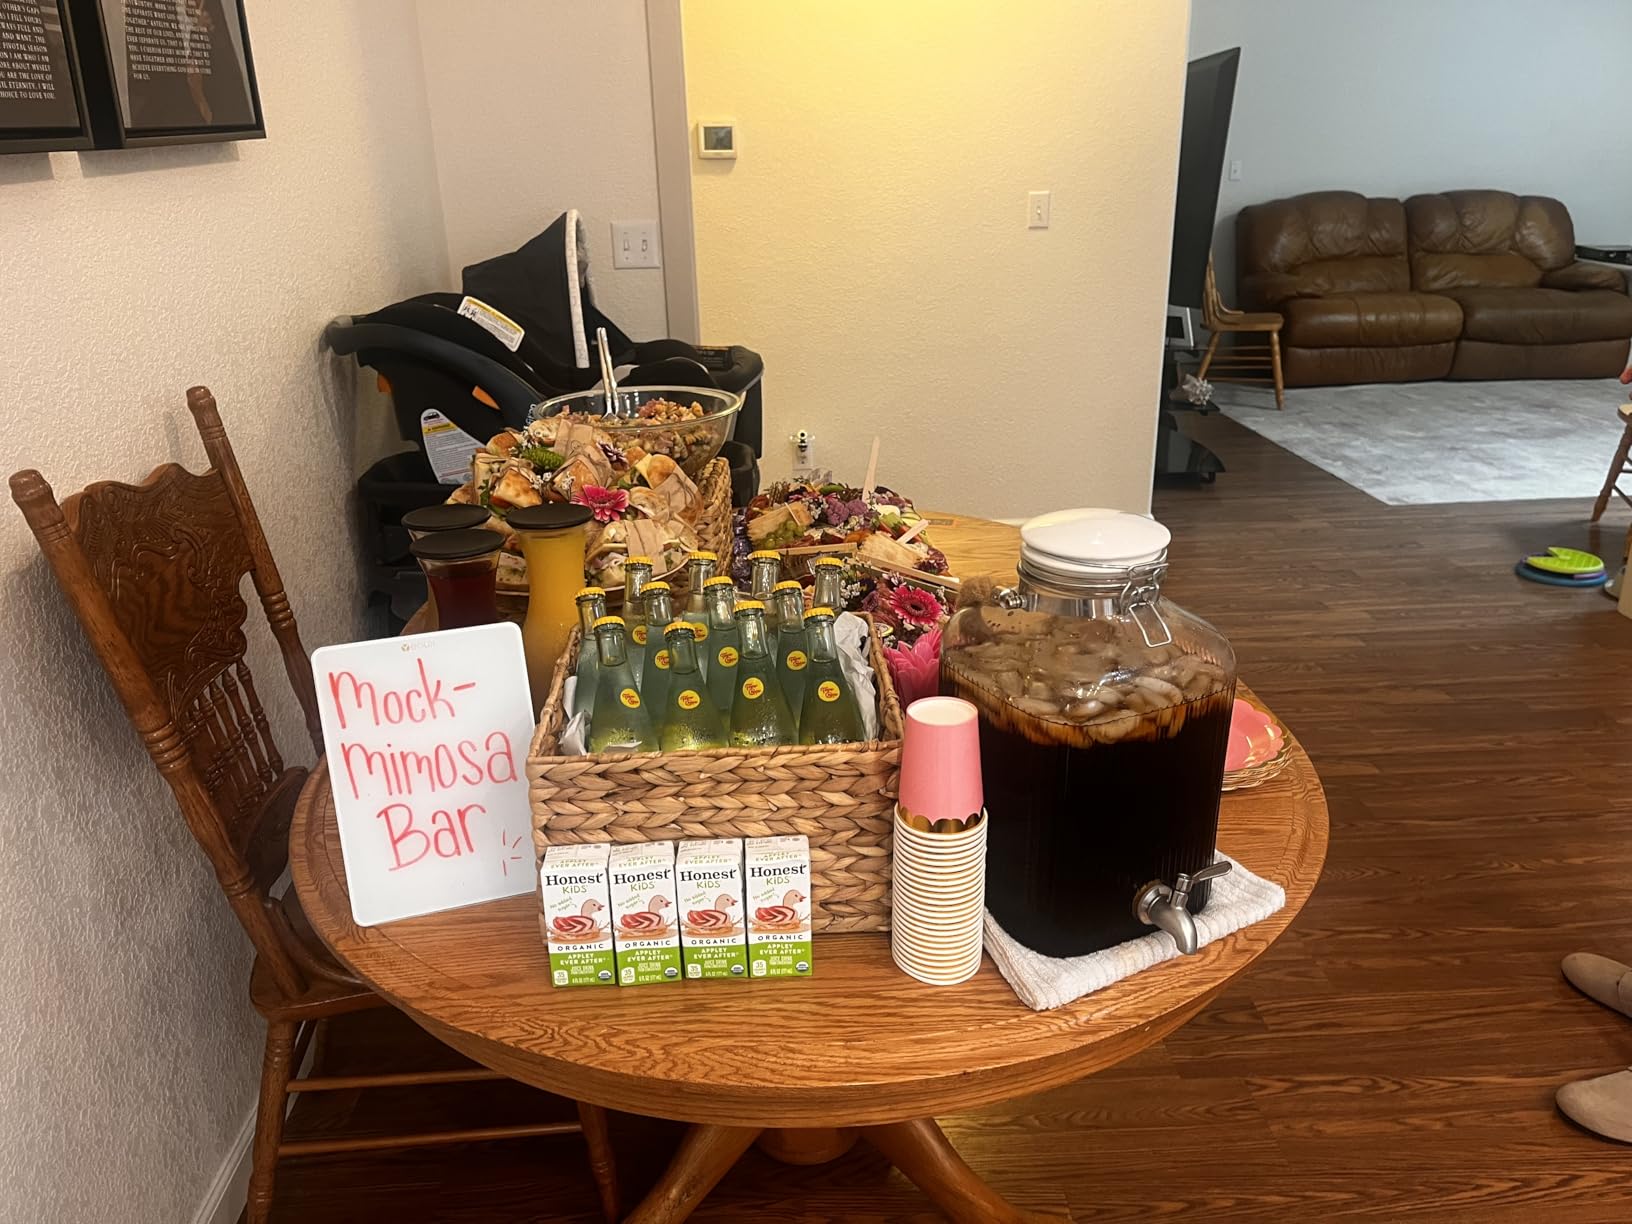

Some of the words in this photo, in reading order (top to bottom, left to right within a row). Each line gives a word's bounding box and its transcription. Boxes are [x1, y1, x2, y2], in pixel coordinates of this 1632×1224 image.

[376, 802, 486, 872] Bar
[613, 869, 671, 884] Honest
[680, 868, 736, 881] Honest
[750, 864, 807, 877] Honest
[545, 872, 603, 886] Honest
[625, 940, 671, 948] ORGANIC
